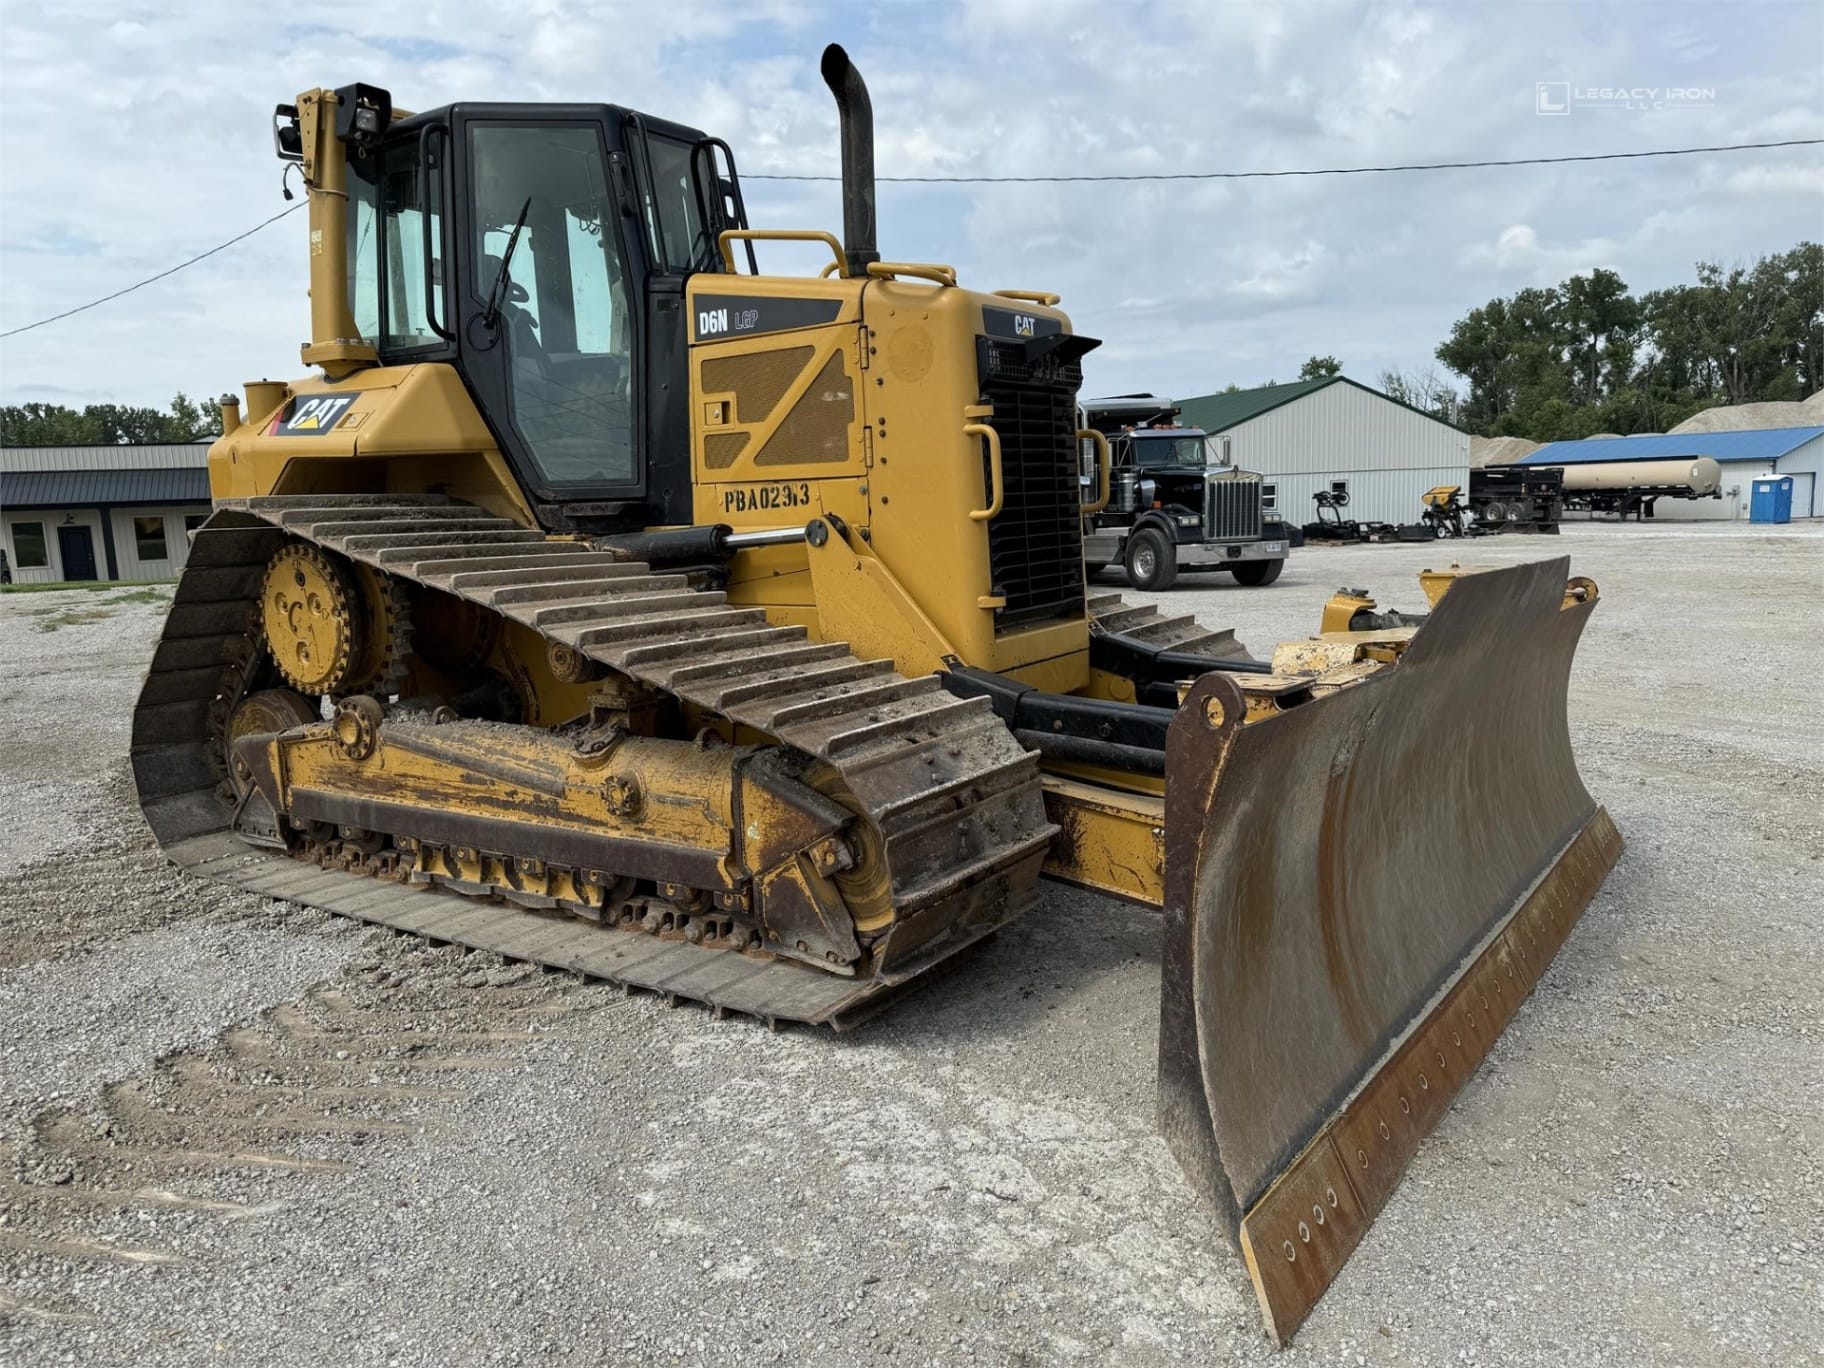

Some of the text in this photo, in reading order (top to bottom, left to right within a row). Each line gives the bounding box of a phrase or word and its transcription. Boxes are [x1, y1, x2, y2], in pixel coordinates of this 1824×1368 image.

[699, 308, 759, 335] D6N LGP
[1014, 314, 1036, 337] CAT
[286, 397, 351, 430] CAT
